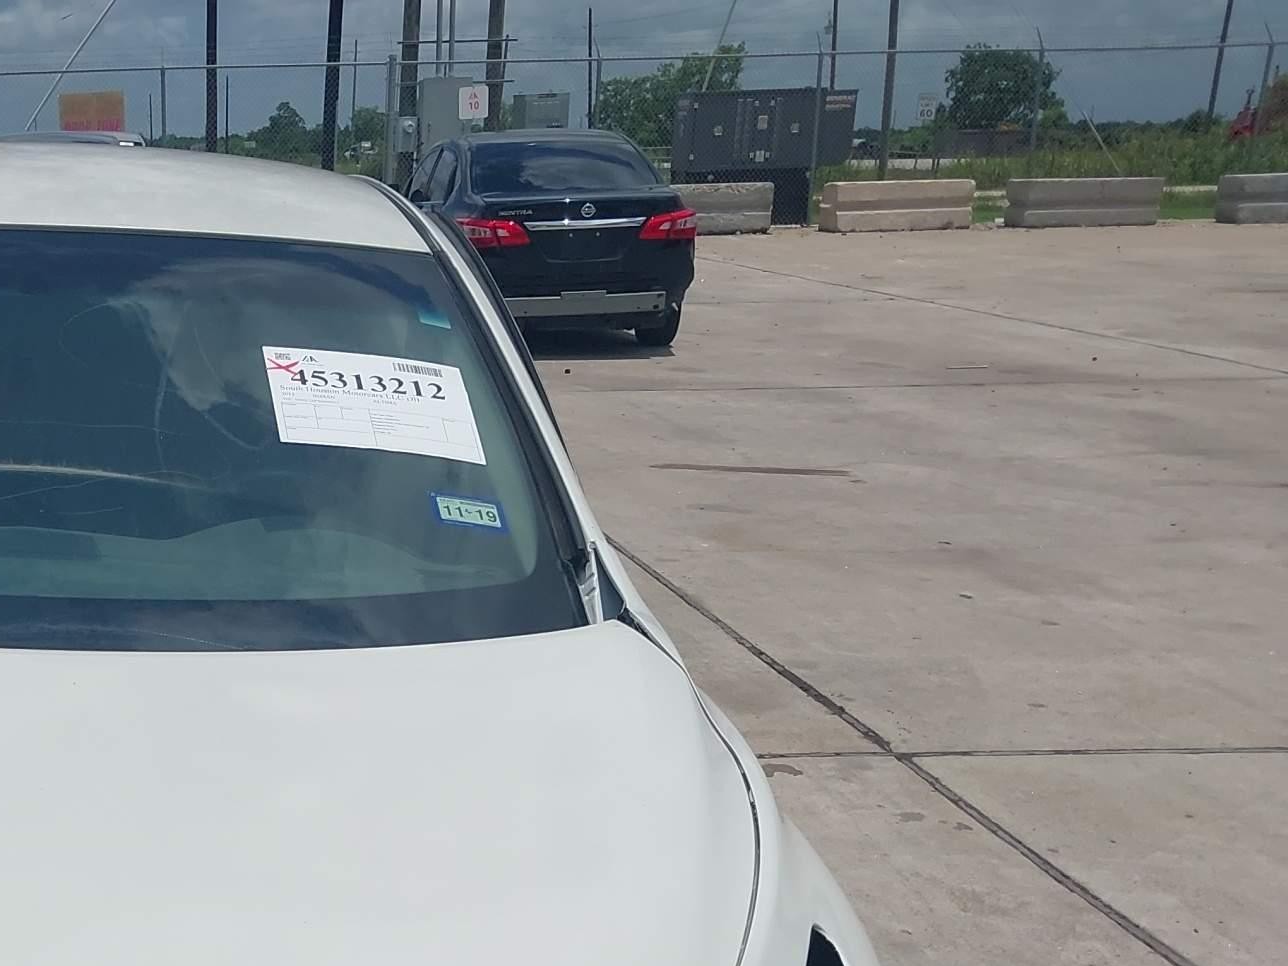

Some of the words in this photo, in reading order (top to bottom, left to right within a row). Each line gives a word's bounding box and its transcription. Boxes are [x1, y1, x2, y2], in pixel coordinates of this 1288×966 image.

[468, 101, 480, 110] 10
[919, 108, 933, 118] 60
[290, 369, 446, 401] 45313212
